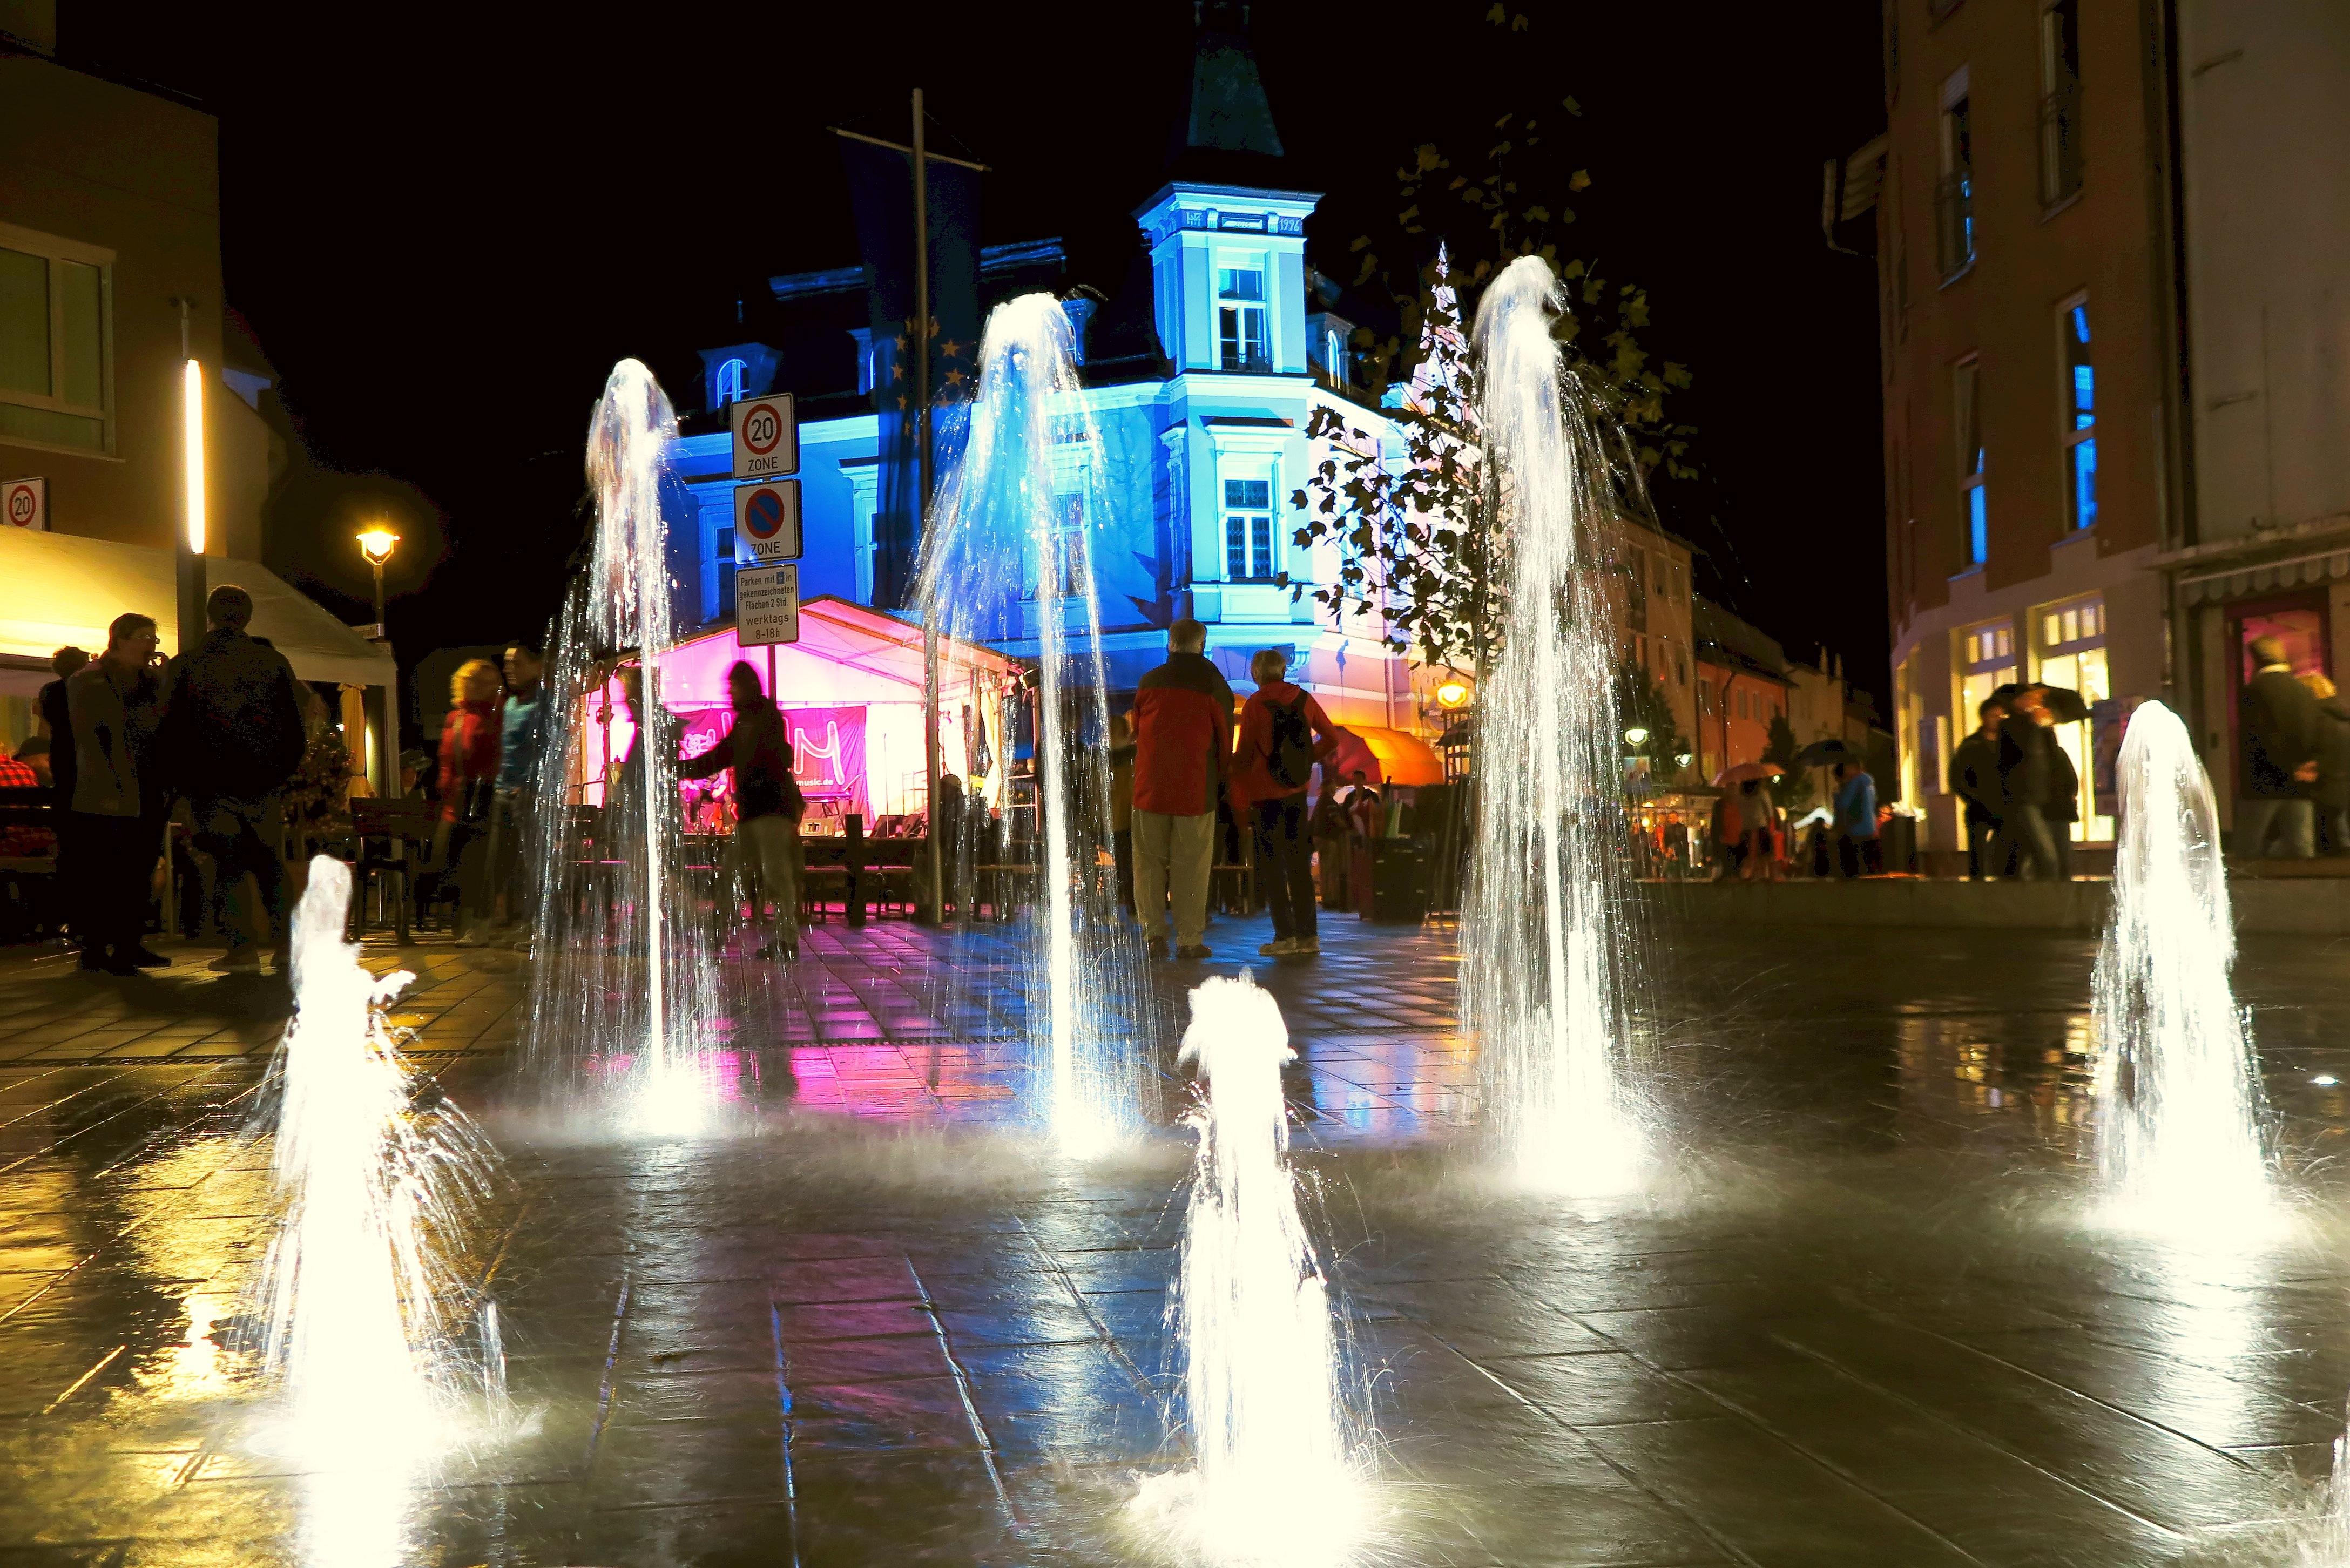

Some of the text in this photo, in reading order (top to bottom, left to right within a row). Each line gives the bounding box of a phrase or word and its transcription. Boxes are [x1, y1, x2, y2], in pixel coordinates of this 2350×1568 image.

[1279, 218, 1301, 232] 1996
[751, 417, 773, 442] 20
[748, 456, 778, 472] ZONE
[15, 496, 30, 516] 20
[751, 541, 780, 556] ZONE
[740, 574, 792, 586] Parken mit in
[739, 586, 794, 601] gekennzeichneten
[771, 598, 774, 608] 2
[746, 614, 789, 625] werktags
[755, 627, 780, 639] 8-18h
